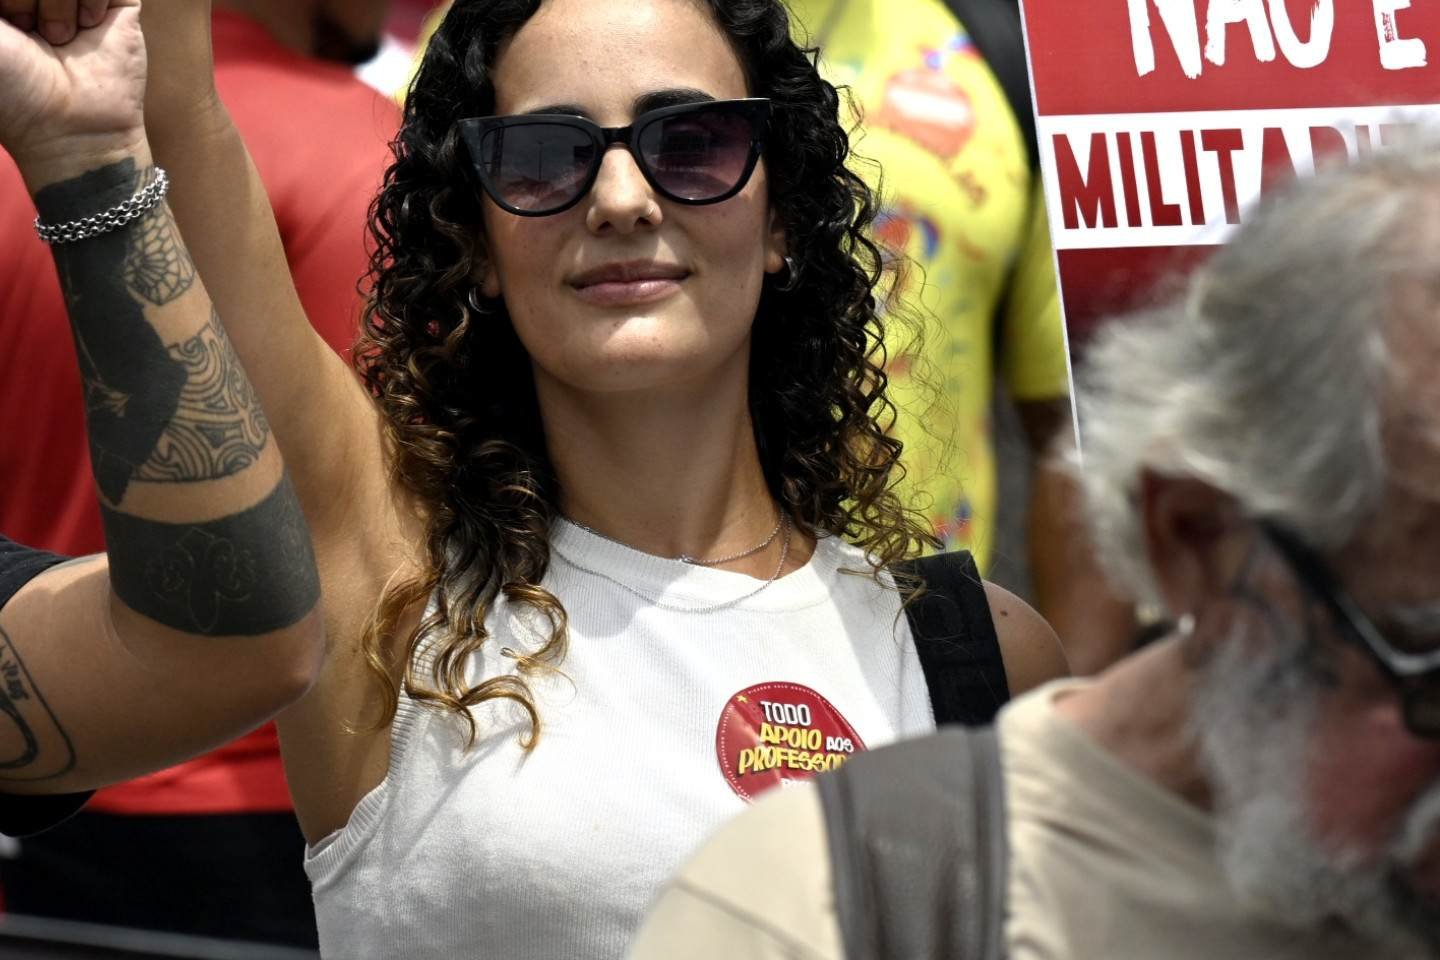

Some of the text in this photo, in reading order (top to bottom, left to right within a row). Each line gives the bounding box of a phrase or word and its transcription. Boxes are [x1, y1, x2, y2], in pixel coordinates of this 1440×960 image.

[760, 700, 811, 726] TODO
[760, 722, 854, 753] APOIO AOS
